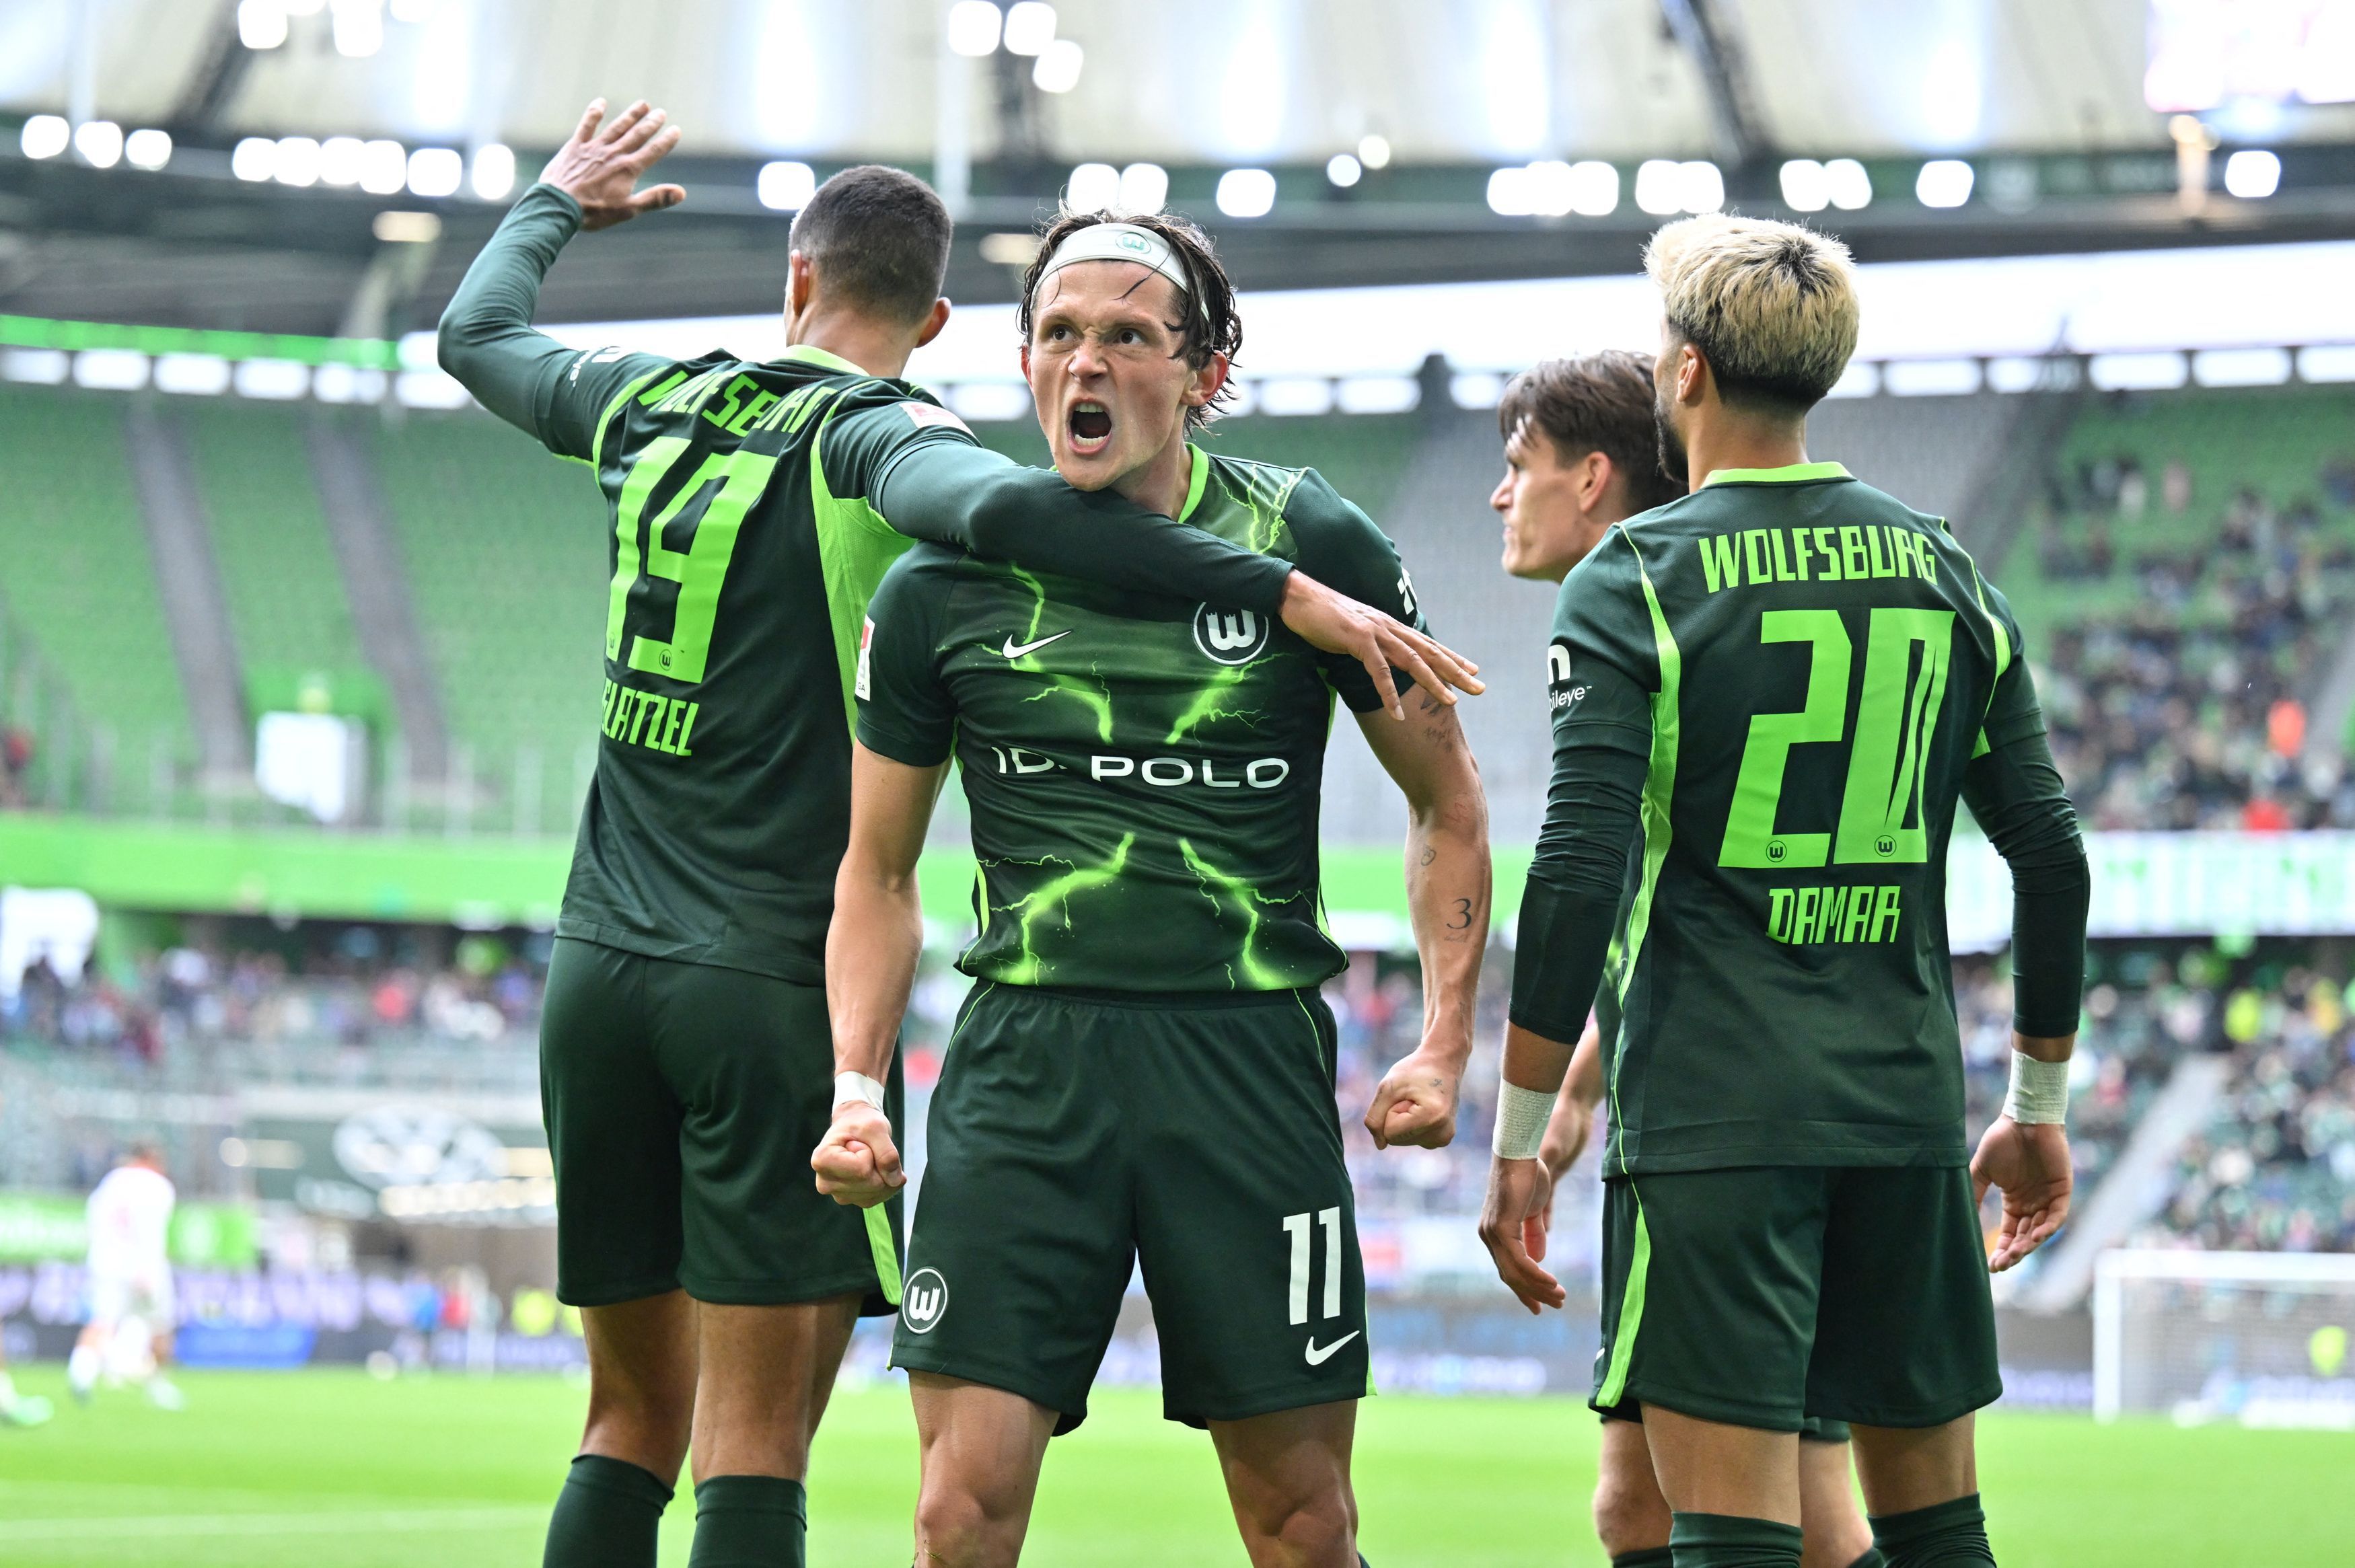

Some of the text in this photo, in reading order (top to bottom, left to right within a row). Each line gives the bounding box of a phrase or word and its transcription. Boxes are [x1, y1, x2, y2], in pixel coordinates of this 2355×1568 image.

[606, 436, 780, 683] 19
[1698, 525, 1938, 594] WOLFSBURG
[1091, 755, 1290, 789] POLO
[1717, 607, 1957, 868] 20
[1446, 898, 1472, 930] 3
[1766, 885, 1901, 944] DAMAR
[1282, 1206, 1341, 1326] 11
